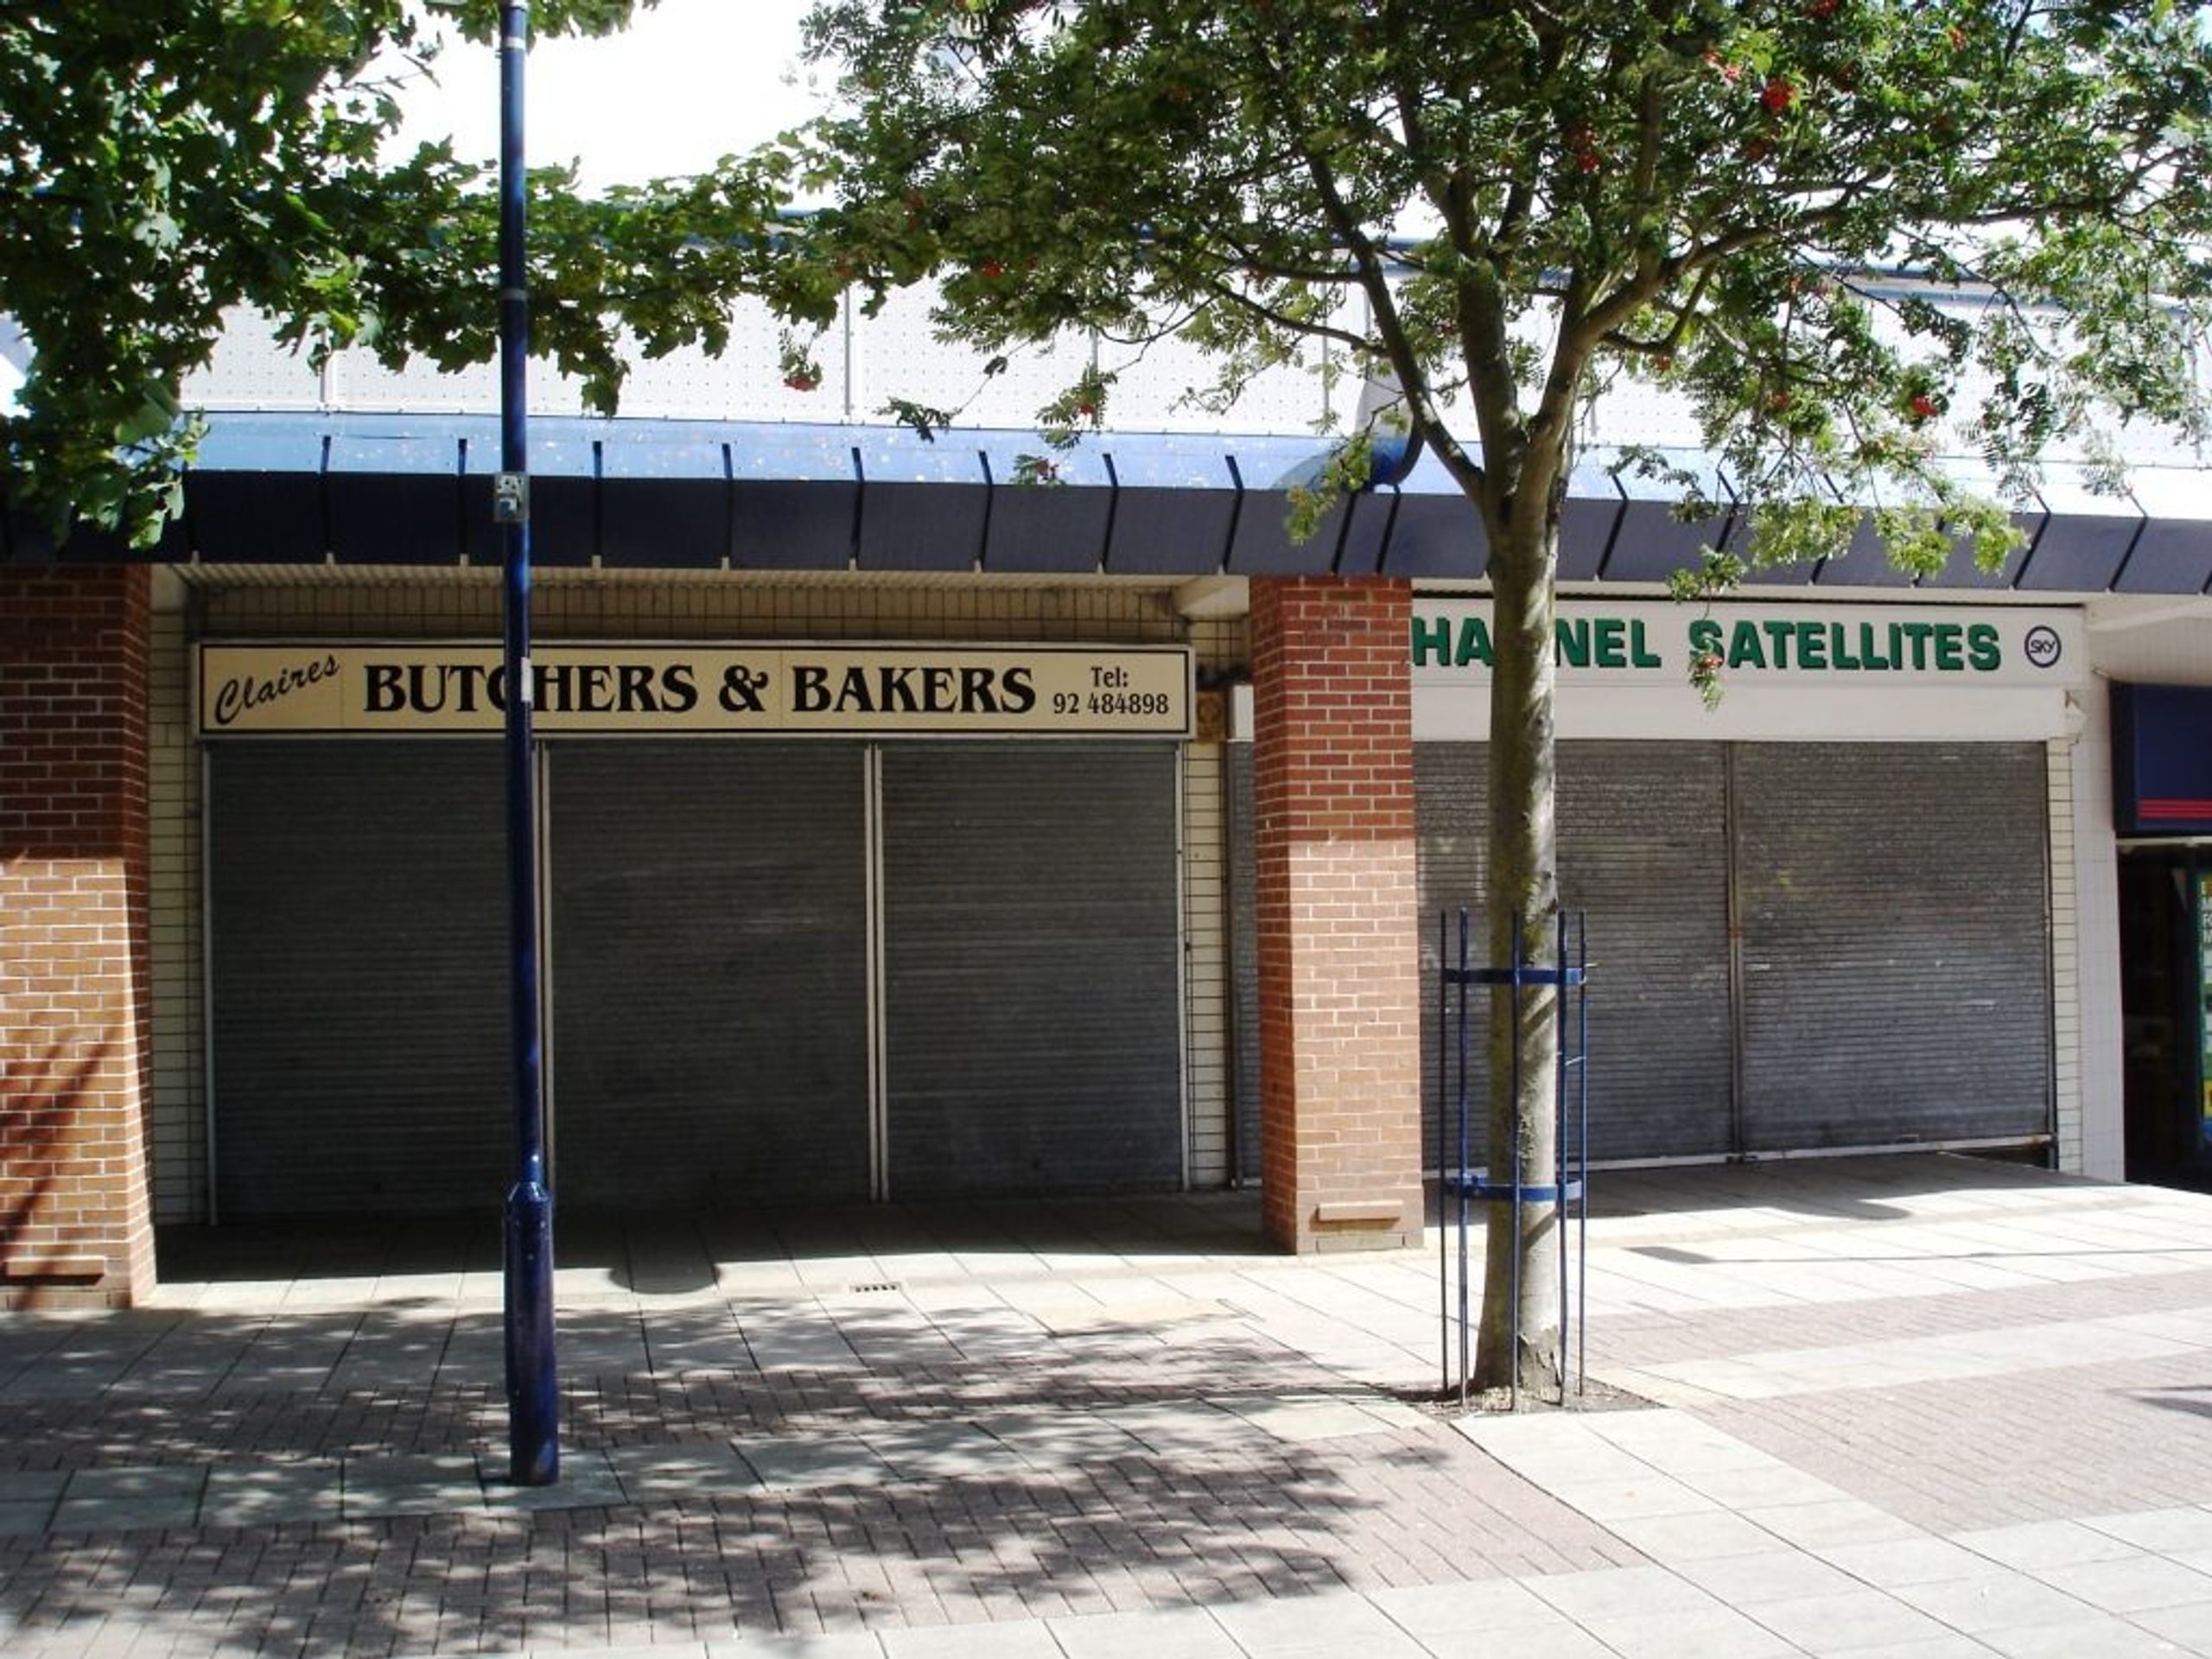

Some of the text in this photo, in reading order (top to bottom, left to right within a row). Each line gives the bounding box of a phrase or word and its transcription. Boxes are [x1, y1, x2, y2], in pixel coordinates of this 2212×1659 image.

[1411, 618, 2002, 671] HANEL SATELLITES
[215, 654, 340, 724] Claires
[719, 665, 768, 712] &
[791, 666, 1036, 714] BAKERS
[1090, 666, 1128, 688] Tel:
[1052, 693, 1169, 715] 92 484898
